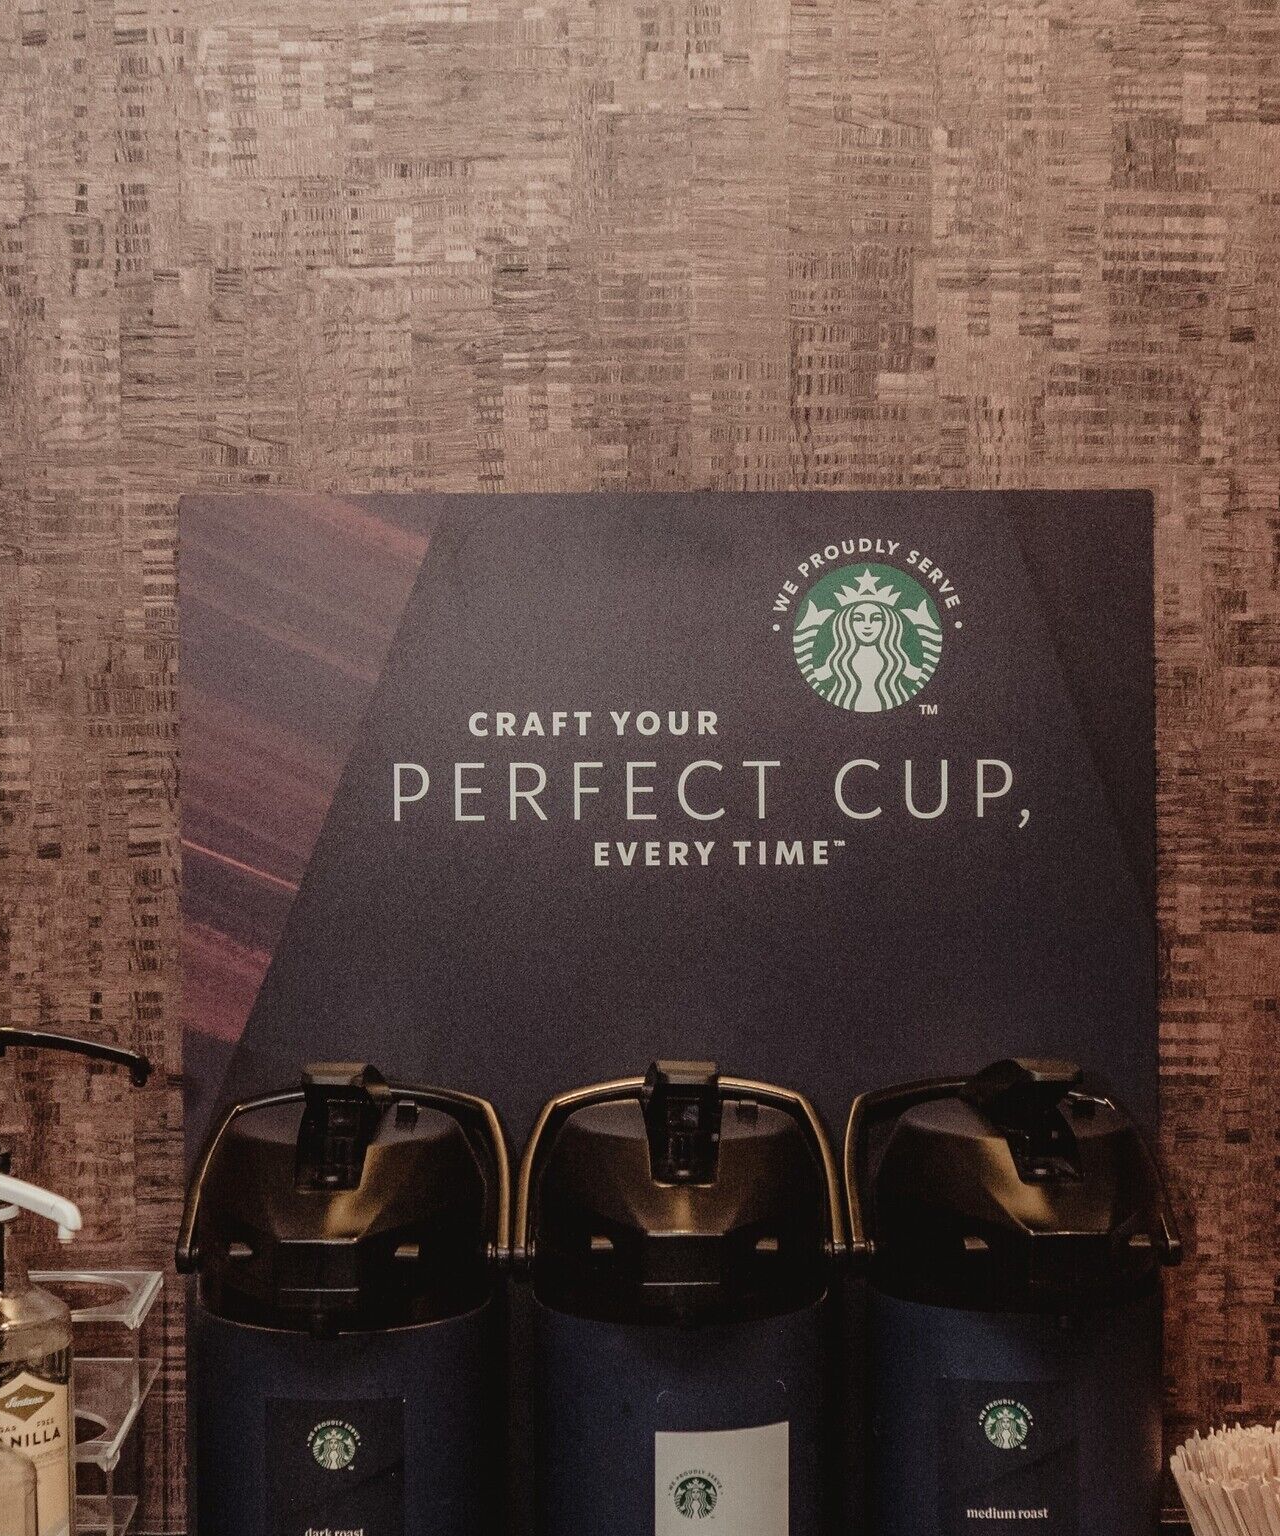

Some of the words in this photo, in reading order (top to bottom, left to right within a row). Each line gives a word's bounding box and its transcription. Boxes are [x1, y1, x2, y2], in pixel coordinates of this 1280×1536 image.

[773, 580, 799, 612] WE
[798, 538, 900, 578] PROUDLY
[906, 550, 961, 609] SERVE
[468, 711, 591, 737] CRAFT
[610, 710, 719, 736] YOUR
[392, 760, 782, 823] PERFECT
[834, 759, 1032, 829] CUP,
[594, 841, 715, 867] EVERY
[0, 1427, 61, 1449] NILLA
[966, 1507, 1016, 1519] medium
[1018, 1507, 1048, 1519] roast
